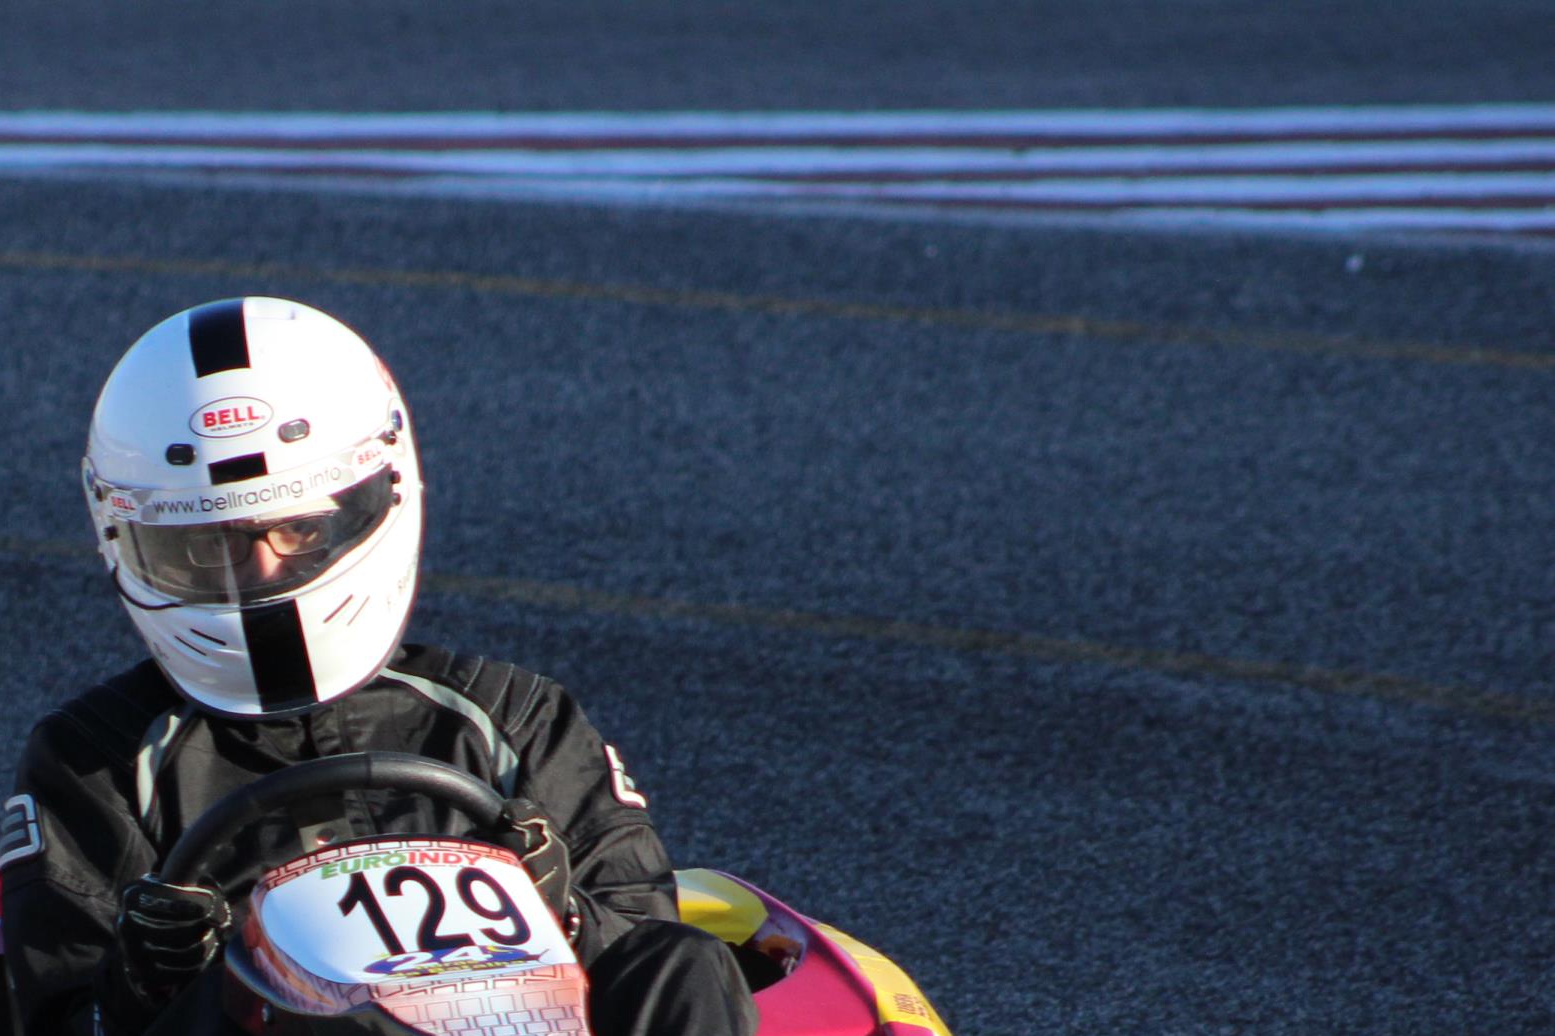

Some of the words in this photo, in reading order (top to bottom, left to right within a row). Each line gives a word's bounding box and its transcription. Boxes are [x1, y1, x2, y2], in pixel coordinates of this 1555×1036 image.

[203, 405, 260, 428] BELL
[111, 496, 136, 510] BELL
[153, 465, 342, 513] www.bellracing.info
[337, 866, 532, 956] 129
